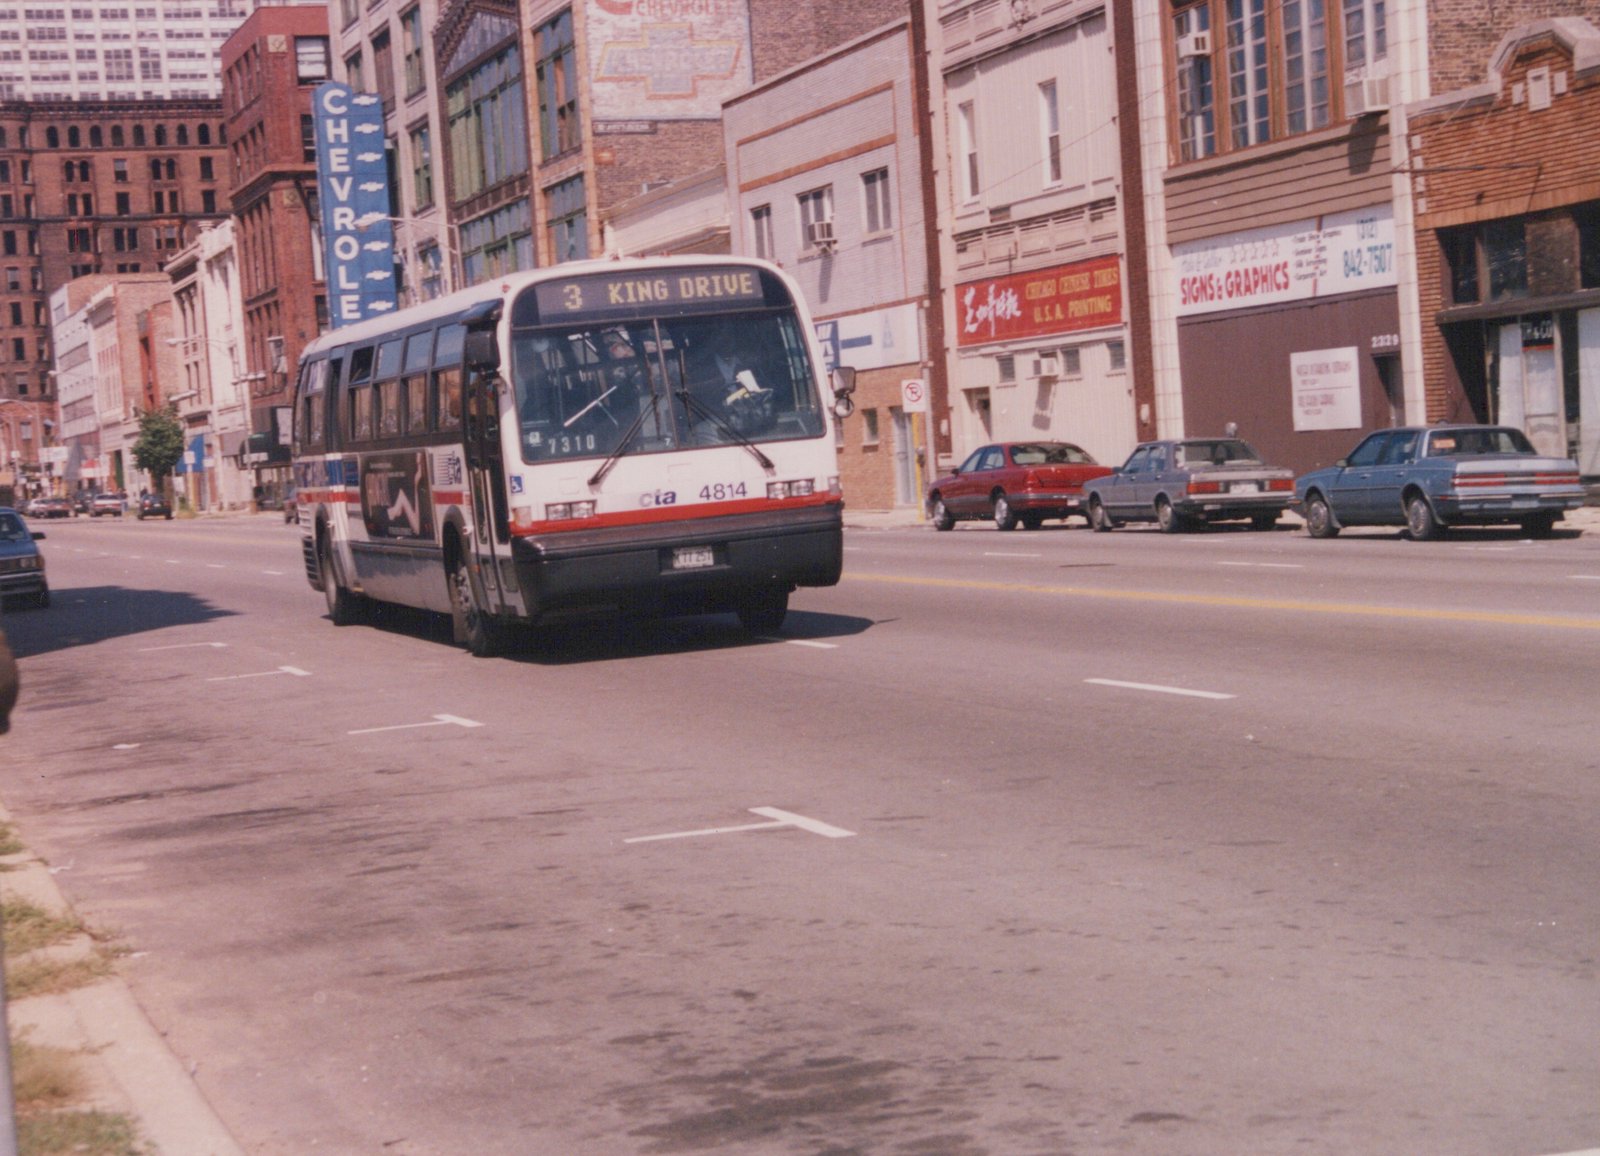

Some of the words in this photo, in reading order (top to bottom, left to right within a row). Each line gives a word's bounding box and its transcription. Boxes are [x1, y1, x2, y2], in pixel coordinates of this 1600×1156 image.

[323, 88, 361, 327] CHEVROLE
[563, 284, 583, 310] 3
[608, 279, 669, 304] KING
[679, 272, 753, 299] DRIVE
[1181, 273, 1215, 305] SIGNS
[1216, 277, 1223, 300] &
[1225, 261, 1289, 298] GRAPHICS
[1068, 294, 1113, 318] PRINTING
[548, 434, 596, 455] 7310
[638, 487, 677, 507] cta
[698, 481, 748, 501] 4814
